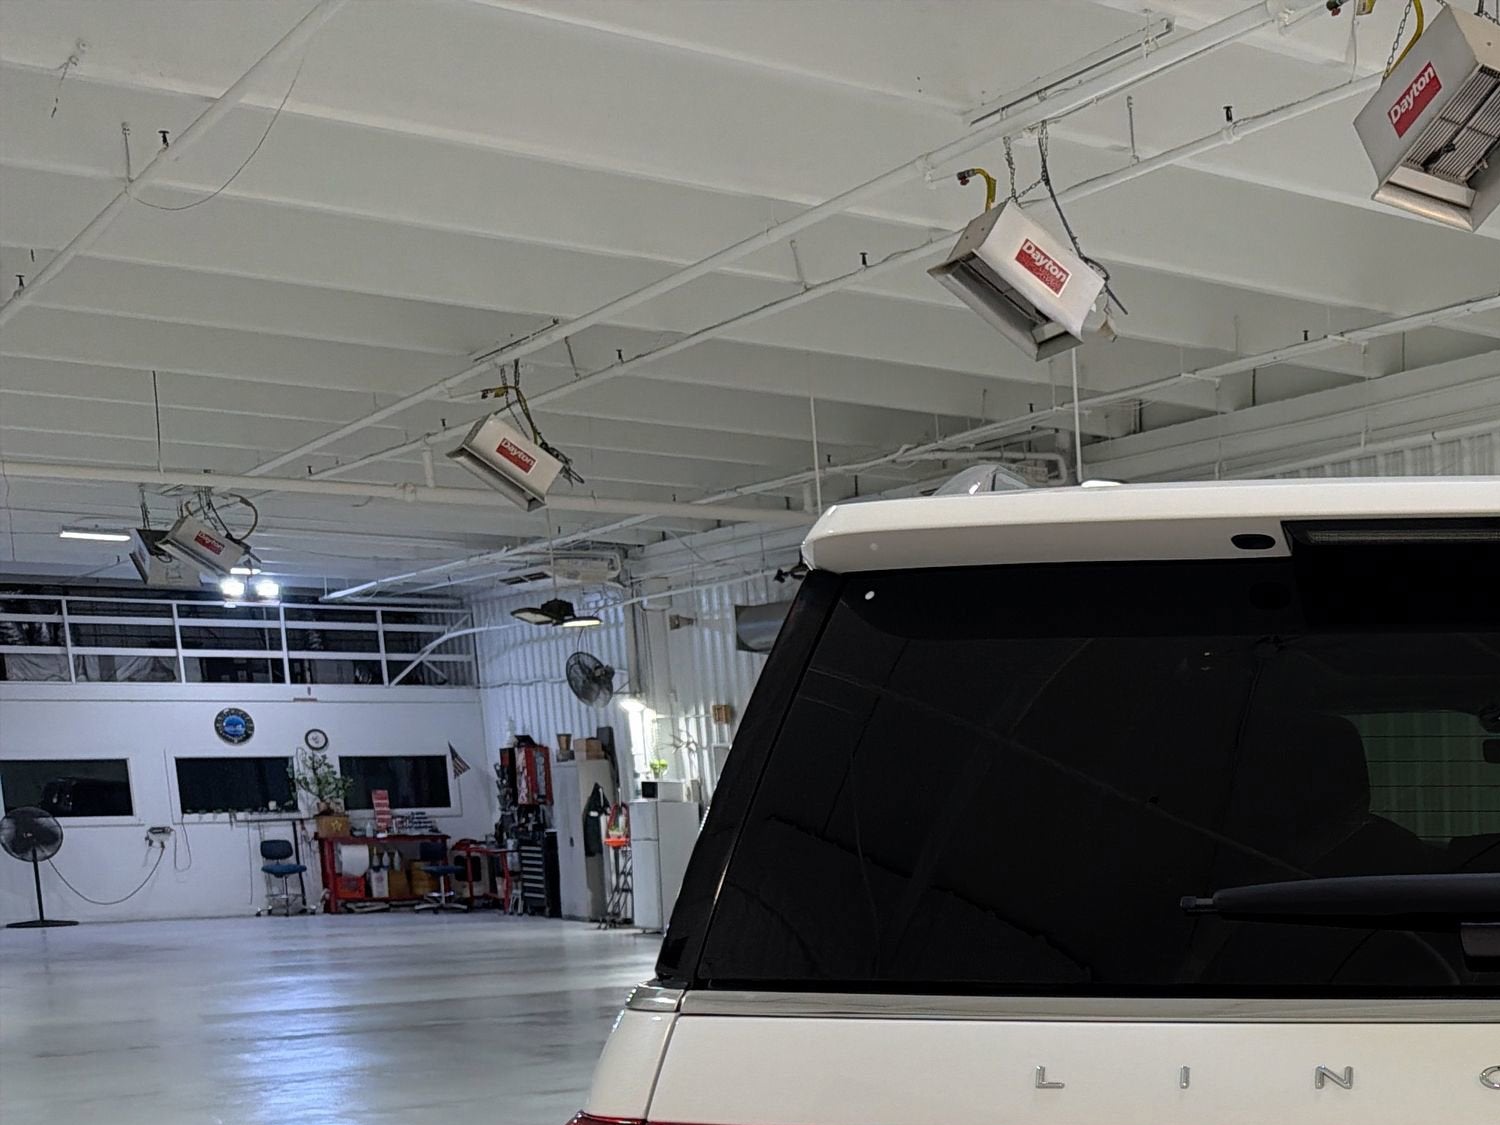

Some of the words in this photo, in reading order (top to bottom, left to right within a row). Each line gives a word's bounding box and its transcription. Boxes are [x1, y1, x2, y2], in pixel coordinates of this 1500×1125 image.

[1390, 66, 1435, 125] Dayton
[1022, 241, 1067, 283] Dayton
[501, 440, 535, 466] Dayton
